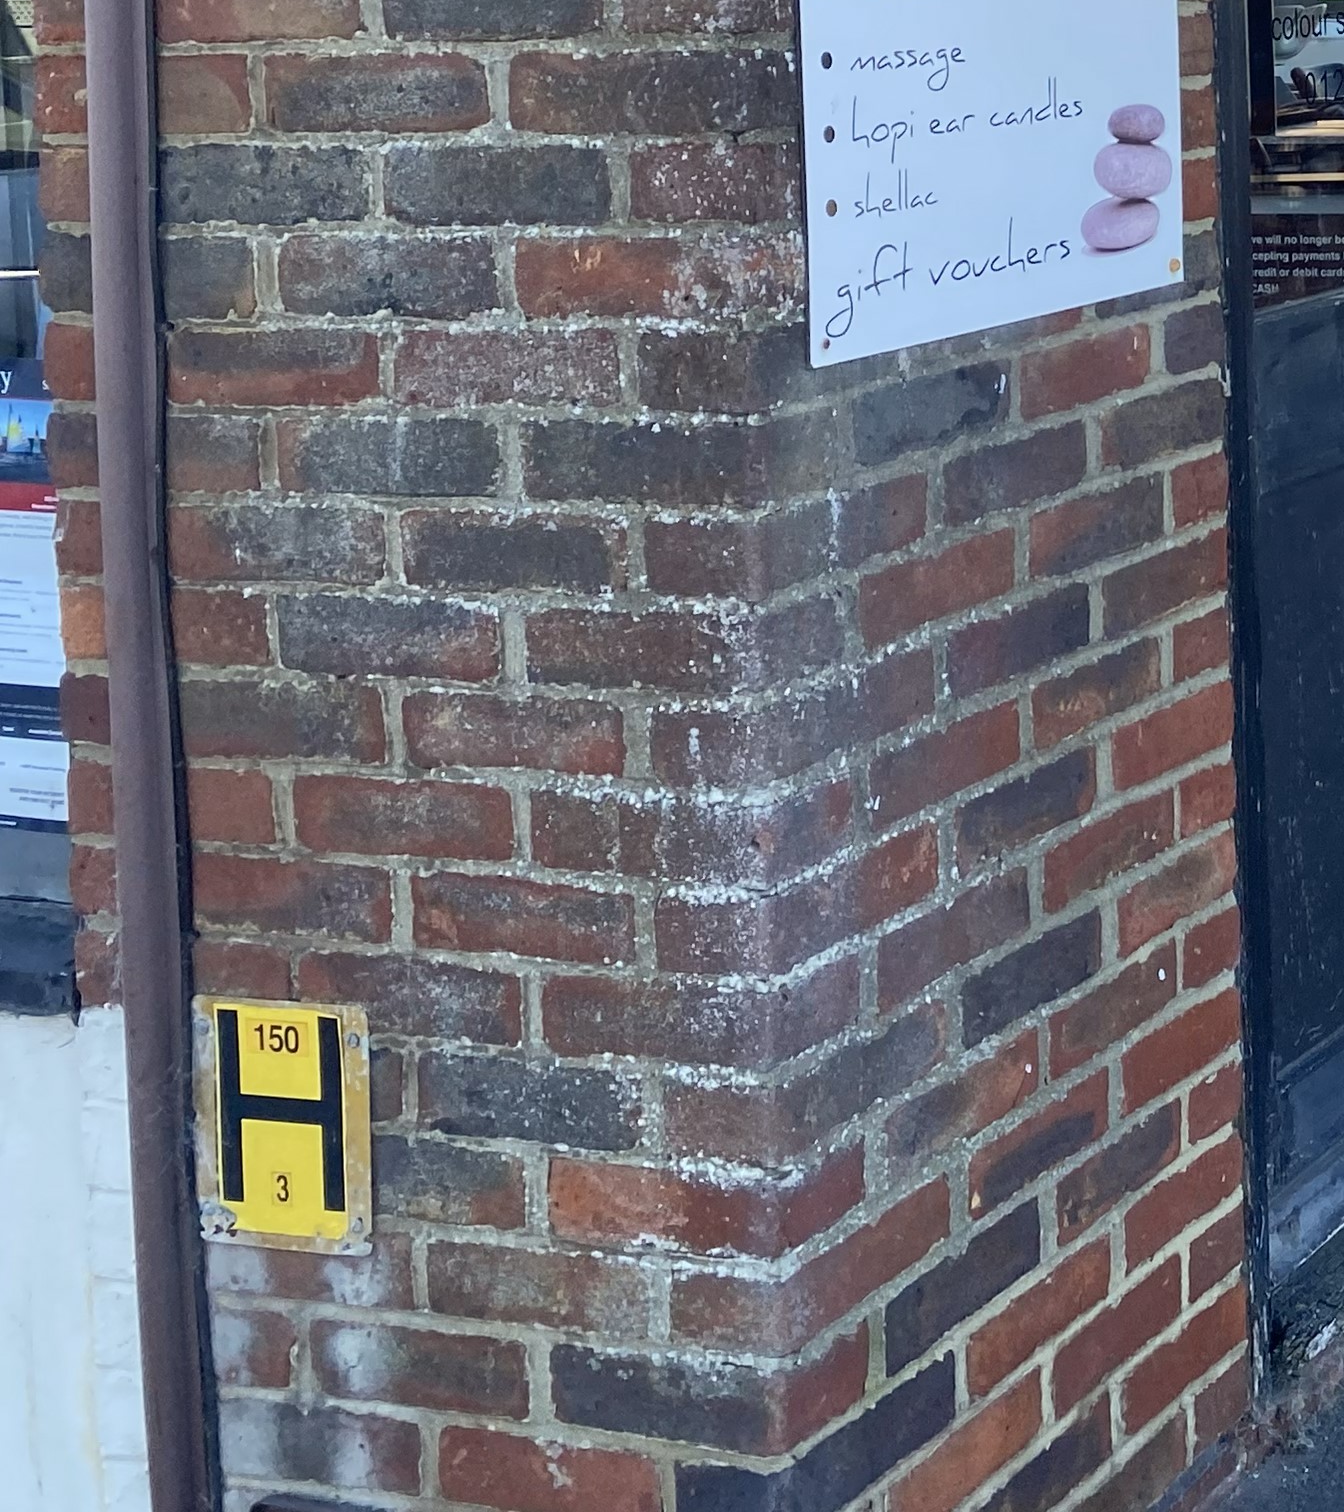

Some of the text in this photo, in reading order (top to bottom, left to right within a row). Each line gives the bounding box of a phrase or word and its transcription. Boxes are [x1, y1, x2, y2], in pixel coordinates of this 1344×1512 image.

[1271, 10, 1328, 41] colour
[850, 45, 966, 91] massage
[851, 76, 1084, 163] hopi ear candles
[853, 167, 939, 218] shellac
[1265, 234, 1282, 245] will
[1284, 236, 1297, 245] no
[1299, 234, 1332, 247] longer
[1252, 251, 1289, 263] cepting
[1292, 251, 1341, 263] payments
[1253, 266, 1277, 277] redit
[1279, 268, 1290, 277] or
[1292, 266, 1318, 277] debit
[825, 216, 1071, 338] gift vouchers
[254, 1023, 301, 1054] 150
[215, 1009, 346, 1211] H
[275, 1174, 290, 1203] 3
